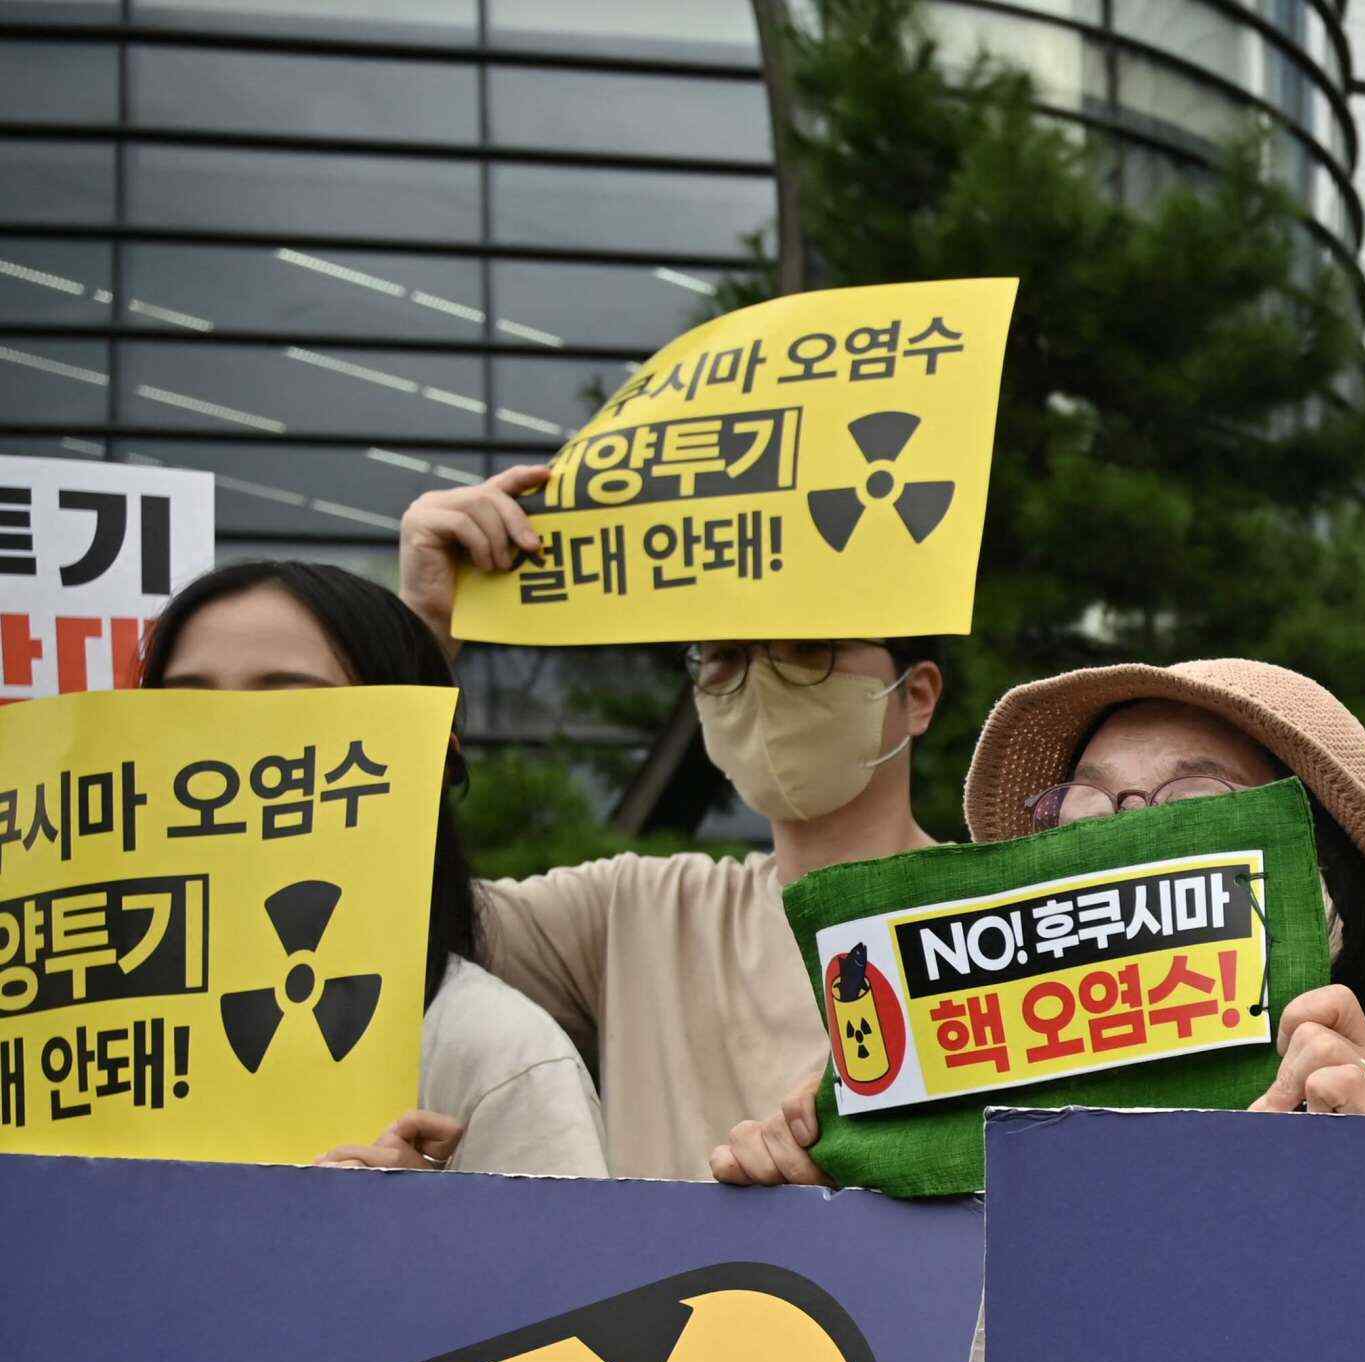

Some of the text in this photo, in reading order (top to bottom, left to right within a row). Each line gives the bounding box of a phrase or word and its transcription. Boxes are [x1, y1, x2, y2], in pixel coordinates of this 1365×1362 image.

[777, 317, 964, 384] 오염수
[642, 510, 785, 592] 안돼!
[166, 740, 392, 841] 오염수
[920, 872, 1231, 982] NO! 후쿠시마
[929, 949, 1242, 1073] 핵 오염수!
[40, 1016, 191, 1122] 안돼!
